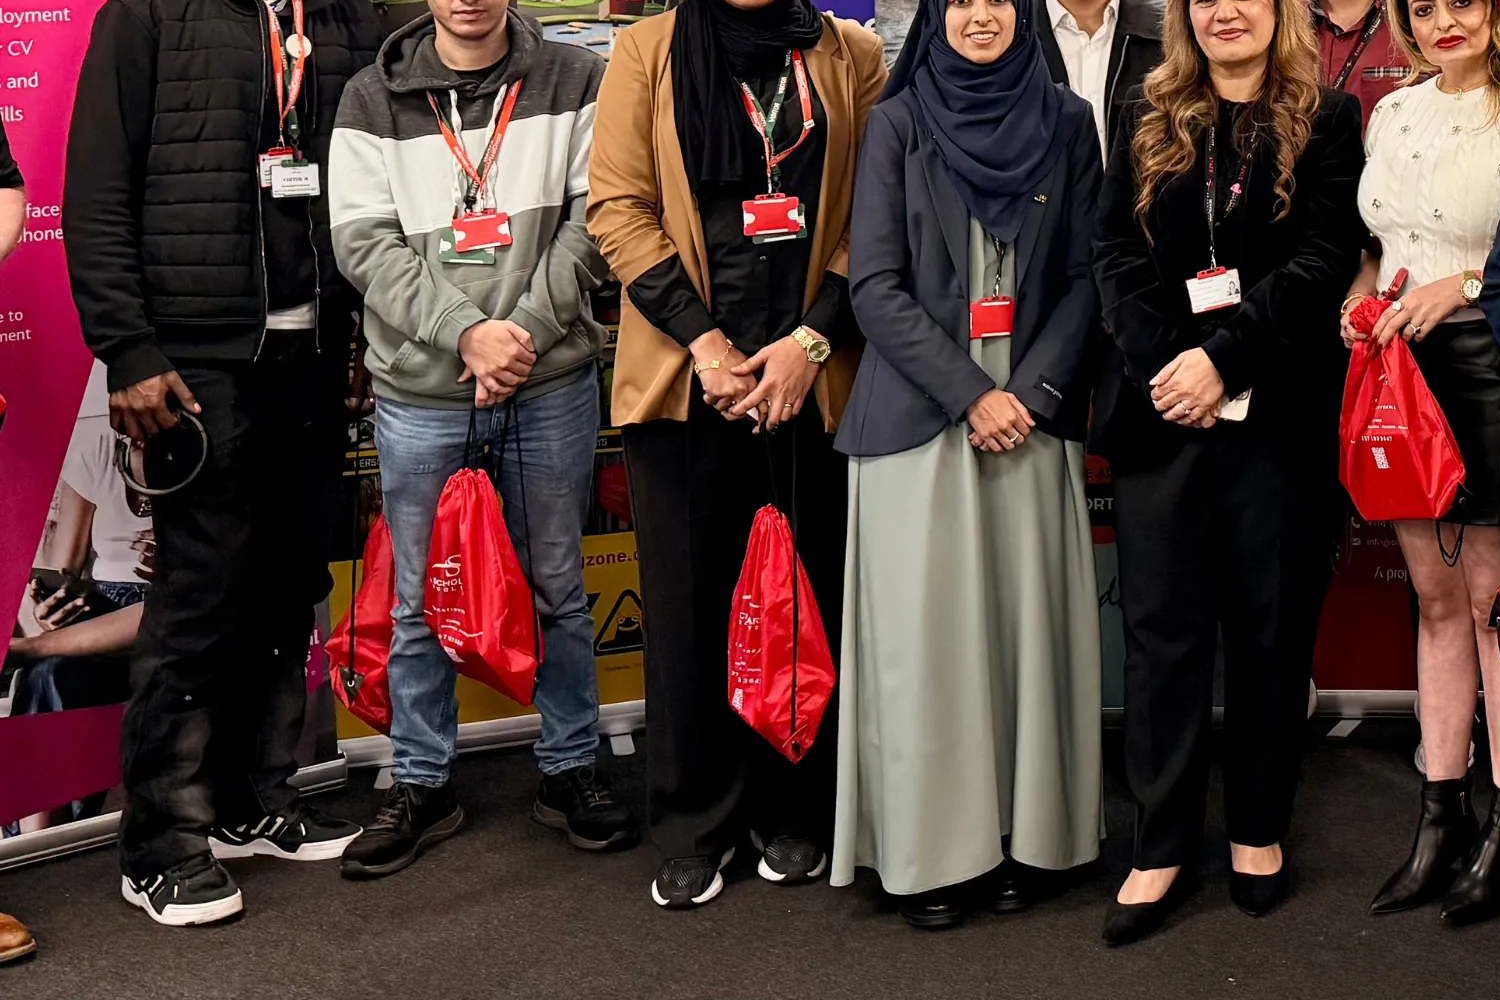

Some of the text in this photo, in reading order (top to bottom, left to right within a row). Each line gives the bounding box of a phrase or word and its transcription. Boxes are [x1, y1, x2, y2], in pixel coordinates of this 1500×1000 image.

[7, 40, 34, 56] CV
[7, 72, 38, 89] and
[9, 310, 23, 322] to
[1386, 567, 1408, 581] proj
